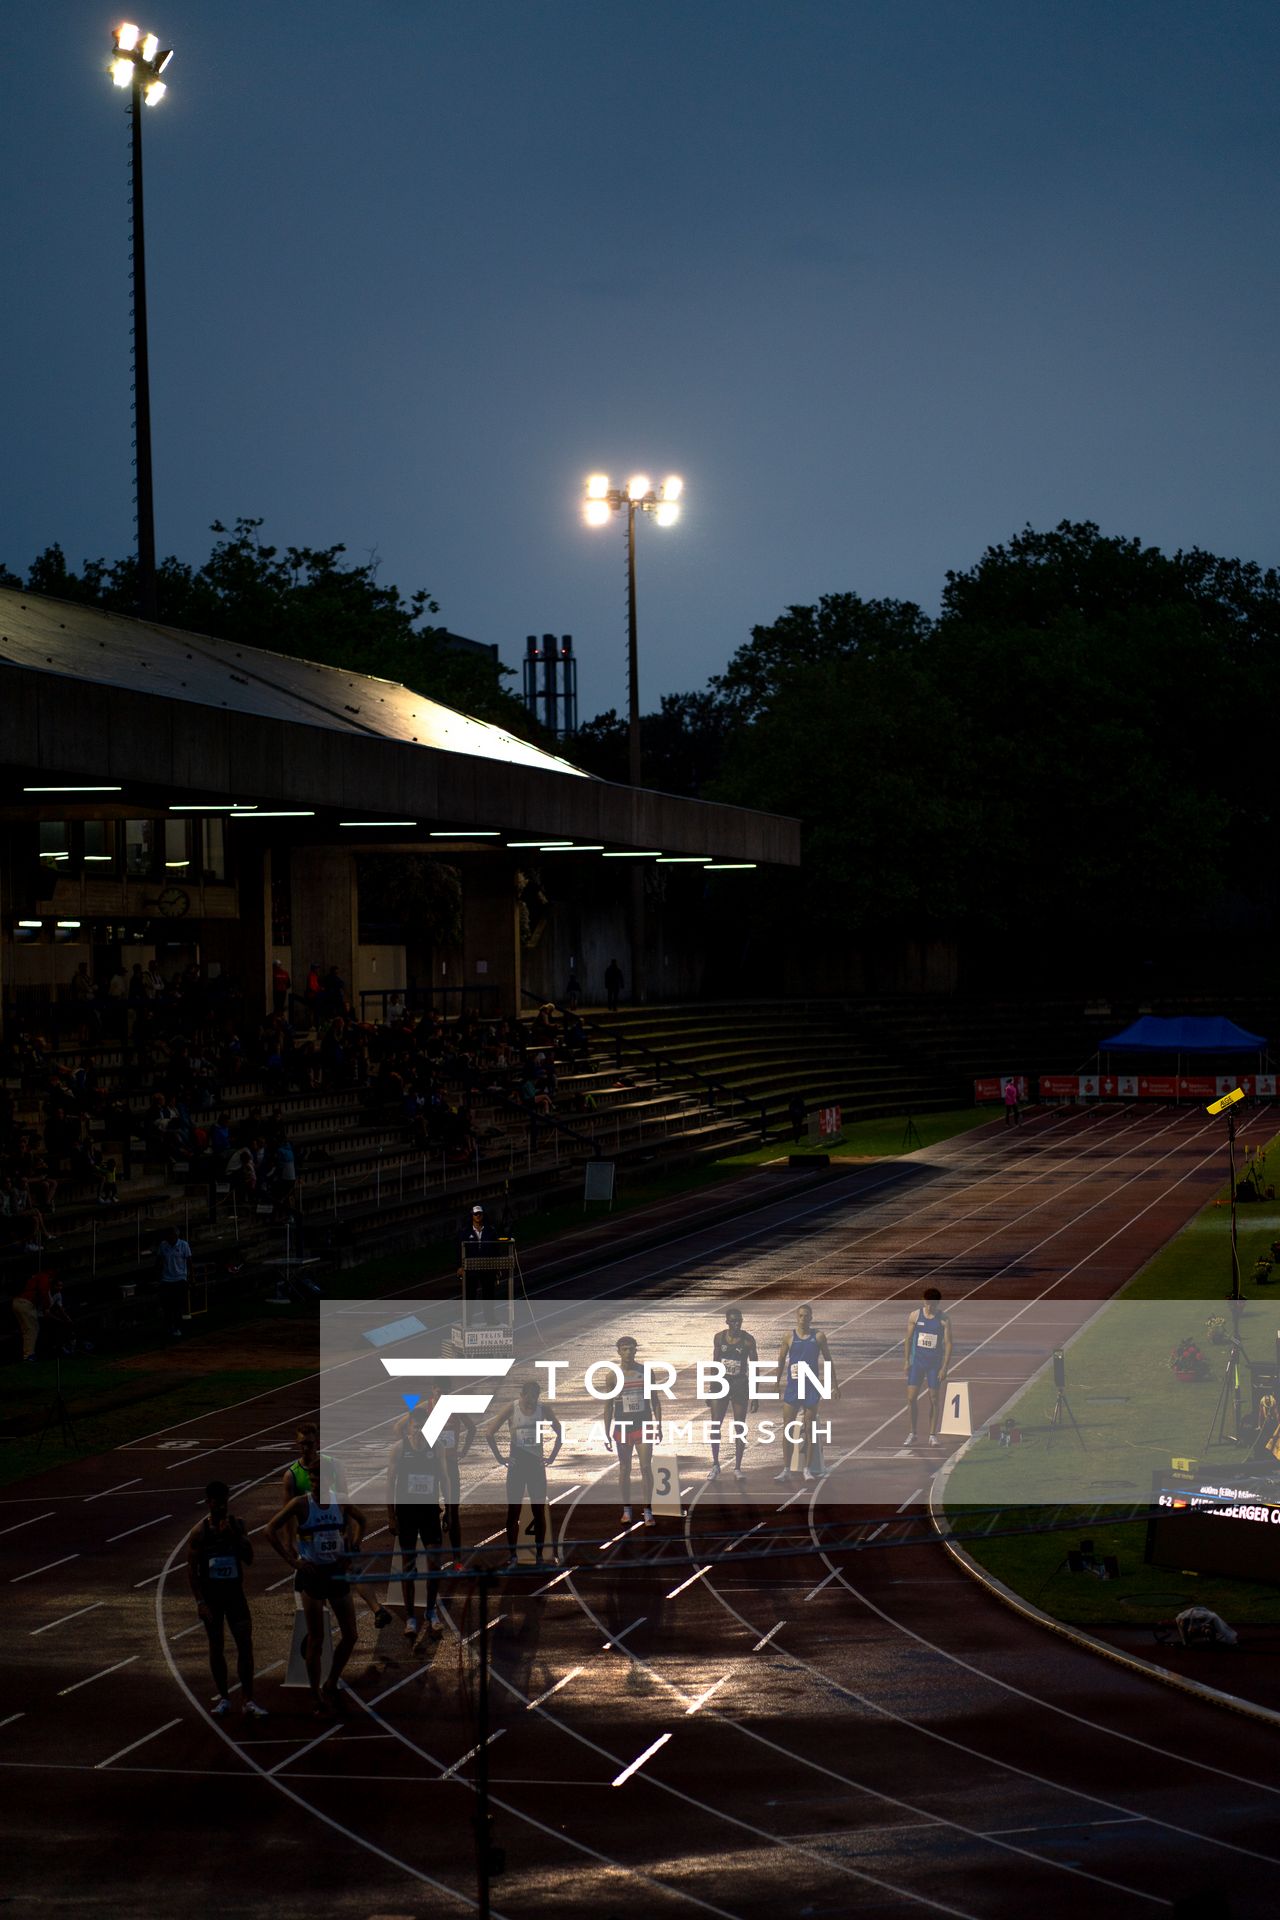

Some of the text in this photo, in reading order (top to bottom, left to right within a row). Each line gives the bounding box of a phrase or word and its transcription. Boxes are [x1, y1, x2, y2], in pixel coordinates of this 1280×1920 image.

[951, 1394, 961, 1419] 1
[656, 1467, 671, 1496] 3
[525, 1518, 537, 1536] 4
